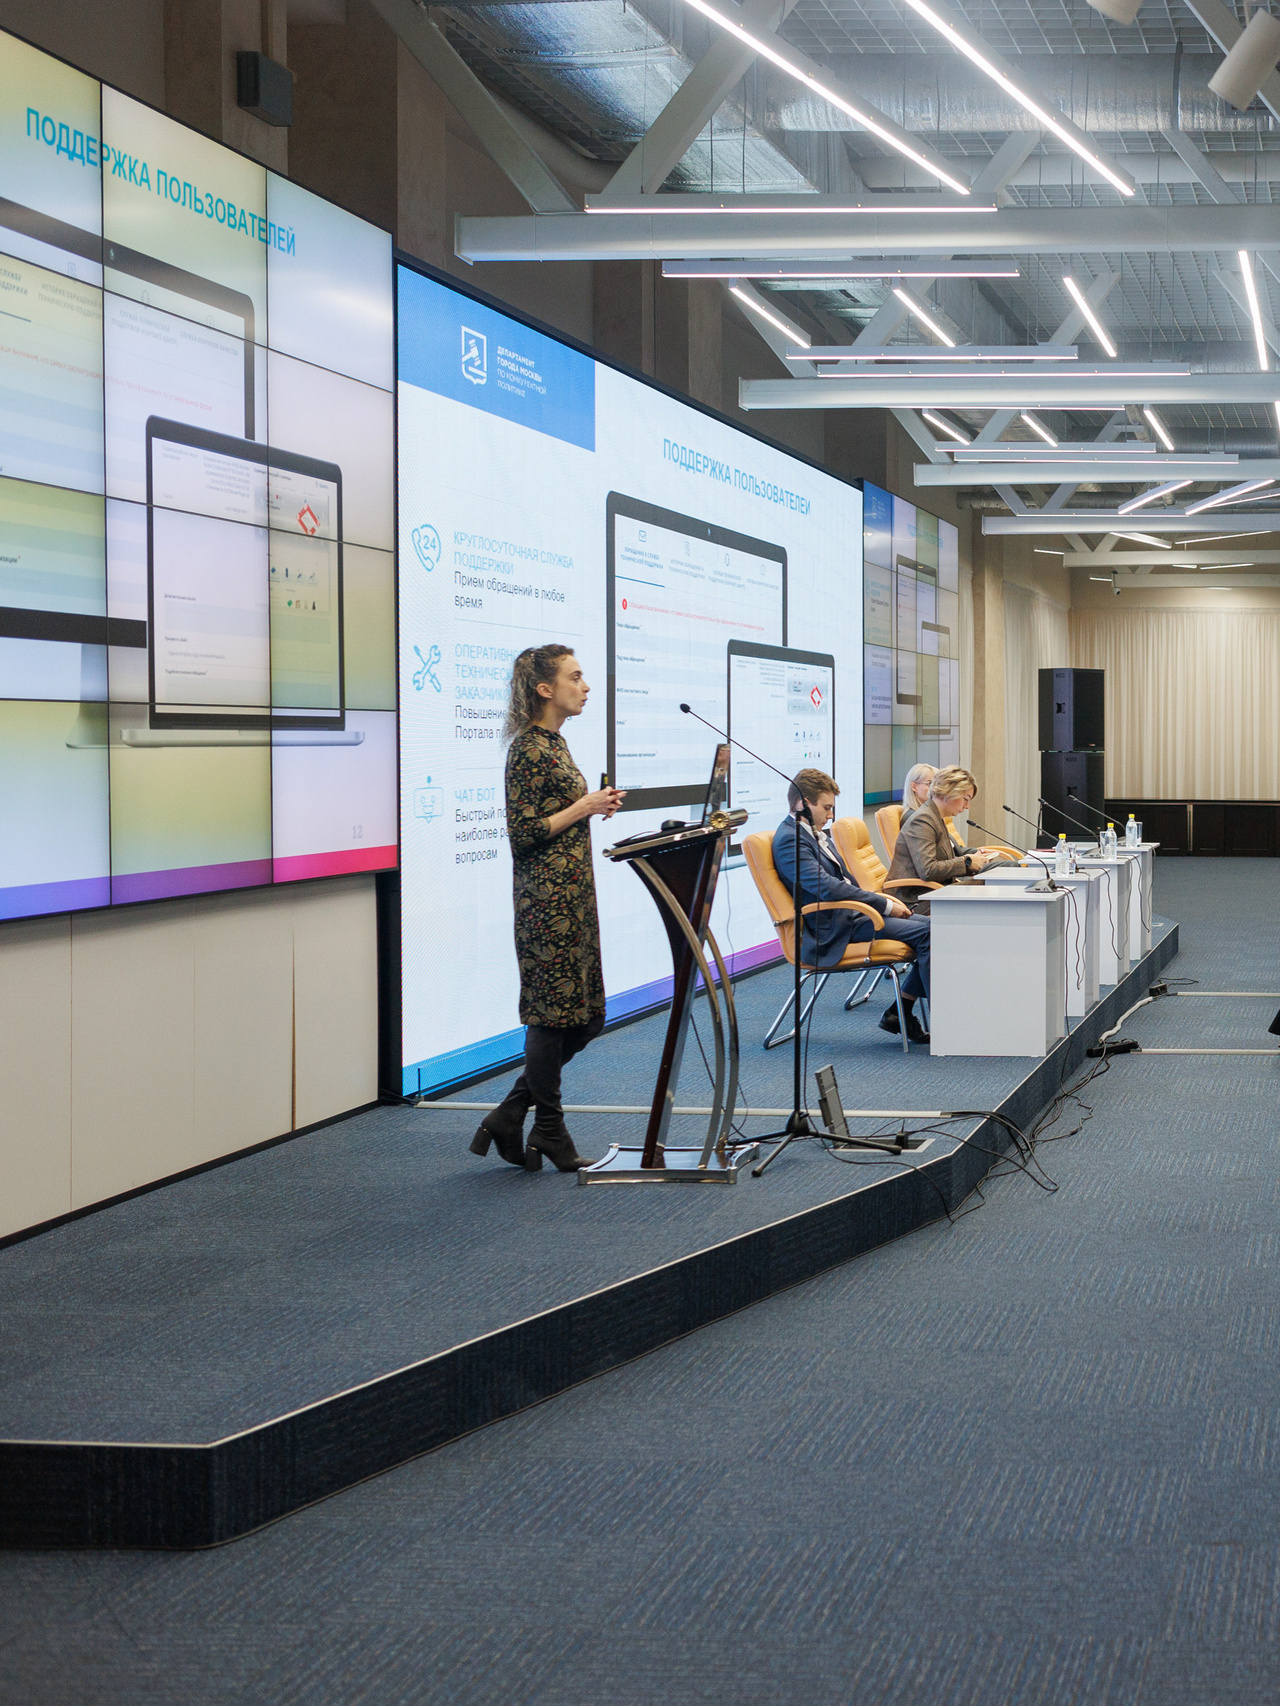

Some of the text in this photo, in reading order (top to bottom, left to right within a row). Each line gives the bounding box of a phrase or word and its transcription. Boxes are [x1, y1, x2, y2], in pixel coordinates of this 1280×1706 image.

[26, 106, 296, 258] ПОДДЕРЖКА ПОЛЬЗОВАТЕЛЕЙ
[497, 345, 535, 369] ДЕПАРТАМЕНТ
[520, 366, 543, 383] МОСКВЫ
[663, 438, 731, 485] ПОДДЕРЖКА
[423, 534, 437, 551] 24
[453, 531, 574, 570] КРУГЛОСУТОЧНАЯ СЛУЖБА
[453, 551, 514, 575] ПОДДЕРЖКИ
[453, 570, 485, 589] Прием
[486, 577, 533, 597] обращений
[541, 588, 566, 603] любое
[453, 595, 483, 609] время
[454, 643, 522, 661] ОПЕРАТИВНО
[454, 663, 513, 681] ТЕХНИЧЕСК
[454, 725, 494, 741] Портала
[454, 787, 496, 802] ЧАТ БОТ
[455, 806, 495, 823] Быстрый
[455, 827, 498, 842] наиболее
[455, 849, 498, 864] вопросам
